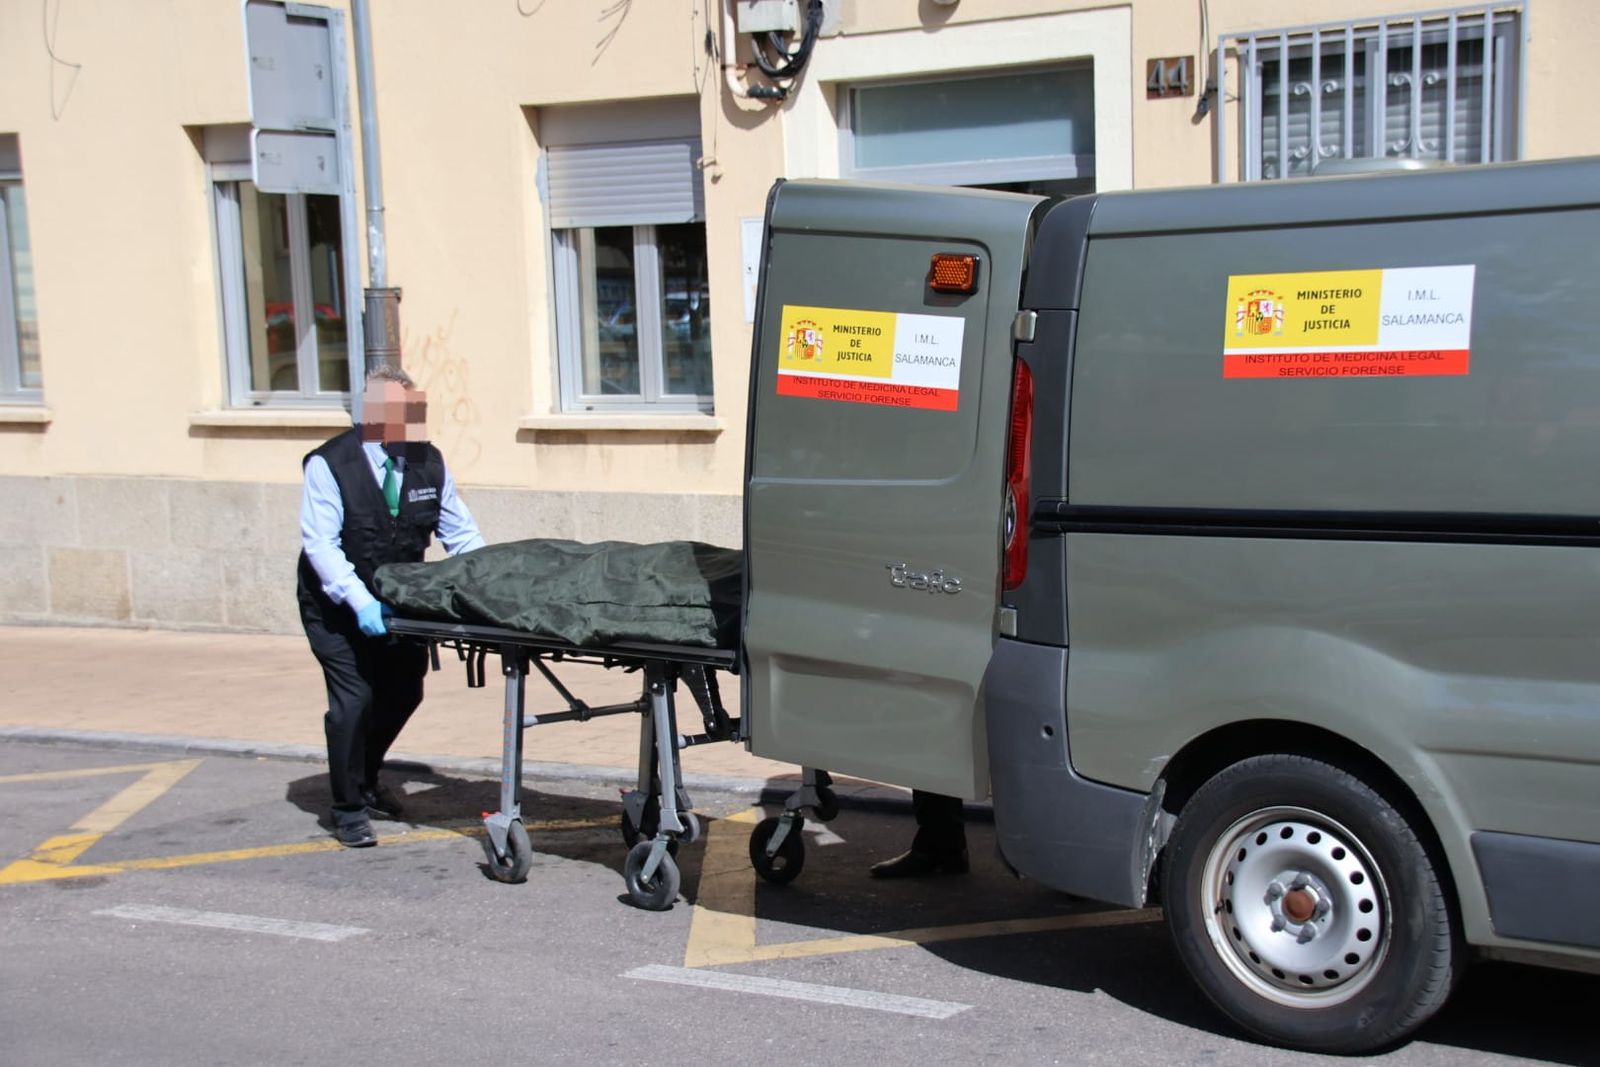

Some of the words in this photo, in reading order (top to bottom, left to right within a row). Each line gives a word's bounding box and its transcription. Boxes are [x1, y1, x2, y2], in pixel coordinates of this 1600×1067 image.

[1148, 58, 1189, 97] 44
[1297, 288, 1362, 300] MINISTERIO
[1407, 289, 1441, 301] I.M.L.
[1320, 304, 1336, 315] DE
[1382, 312, 1464, 326] SALAMANCA
[833, 324, 882, 337] MINISTERIO
[1303, 320, 1350, 332] JUSTICIA
[850, 339, 862, 348] DE
[914, 333, 939, 345] I.M.L.
[836, 352, 872, 362] JUSTICIA
[895, 353, 956, 367] SALAMANCA
[1244, 353, 1310, 364] INSTITUTO
[1312, 352, 1330, 363] DE
[1334, 351, 1399, 362] MEDICINA
[1400, 351, 1445, 361] LEGAL
[1278, 366, 1339, 377] SERVICIO
[1342, 365, 1405, 376] FORENSE
[793, 376, 841, 388] INSTITUTO
[843, 380, 856, 390] DE
[859, 382, 906, 394] MEDICINA
[908, 387, 940, 397] LEGAL
[817, 390, 862, 402] SERVICIO
[864, 394, 911, 406] FORENSE
